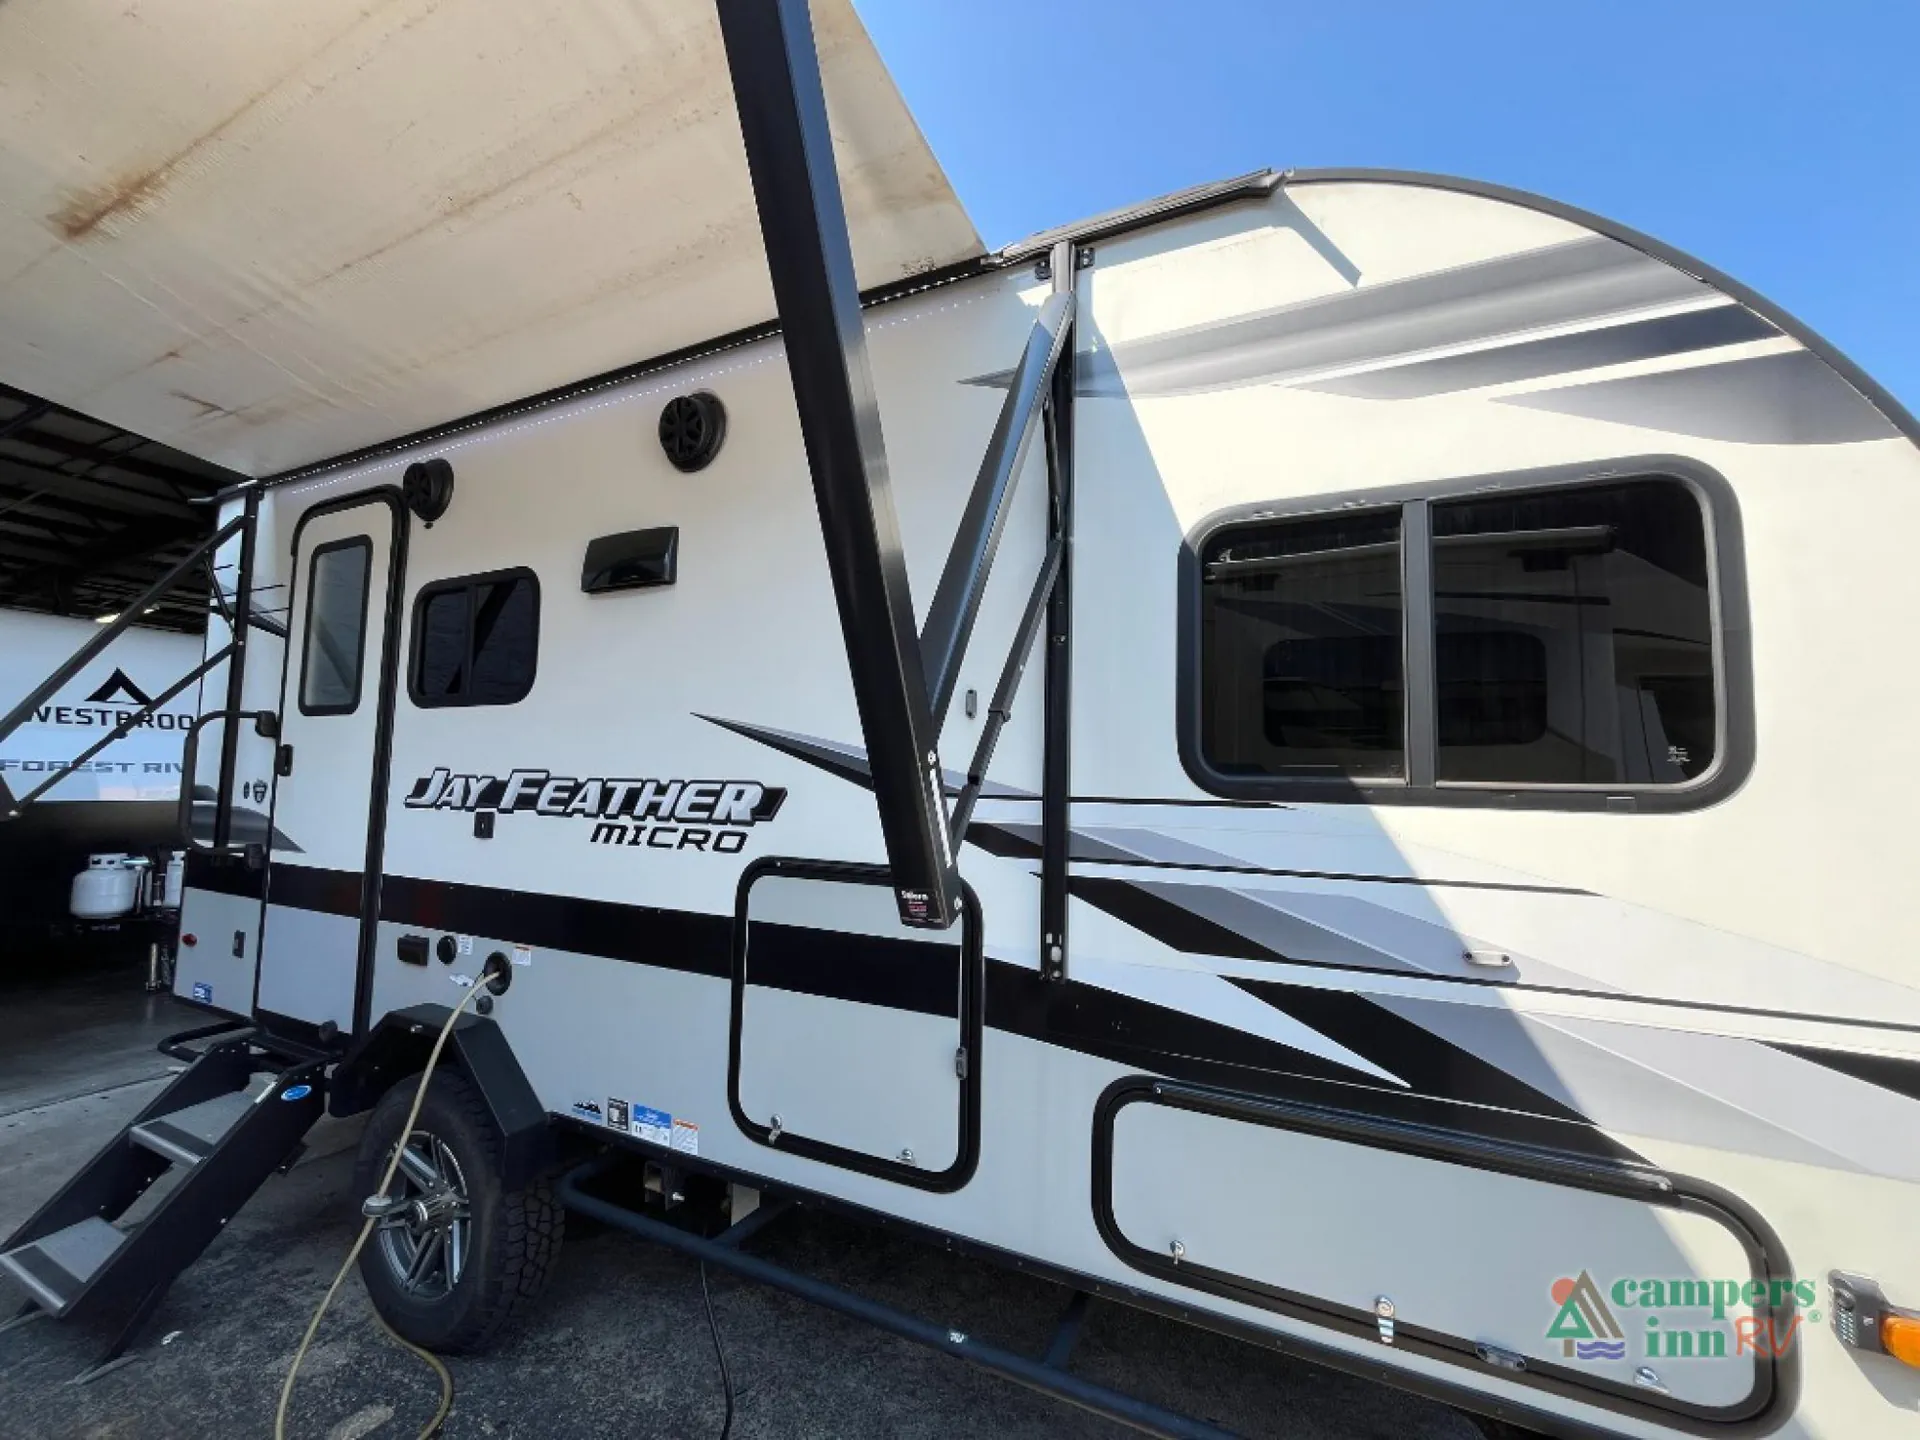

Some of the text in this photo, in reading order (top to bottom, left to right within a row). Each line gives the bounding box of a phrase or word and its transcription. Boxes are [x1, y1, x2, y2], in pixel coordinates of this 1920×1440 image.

[30, 706, 193, 731] WESTBROO
[144, 763, 184, 773] RIV
[405, 767, 764, 826] JAY FEATHER
[590, 822, 748, 853] MICRO
